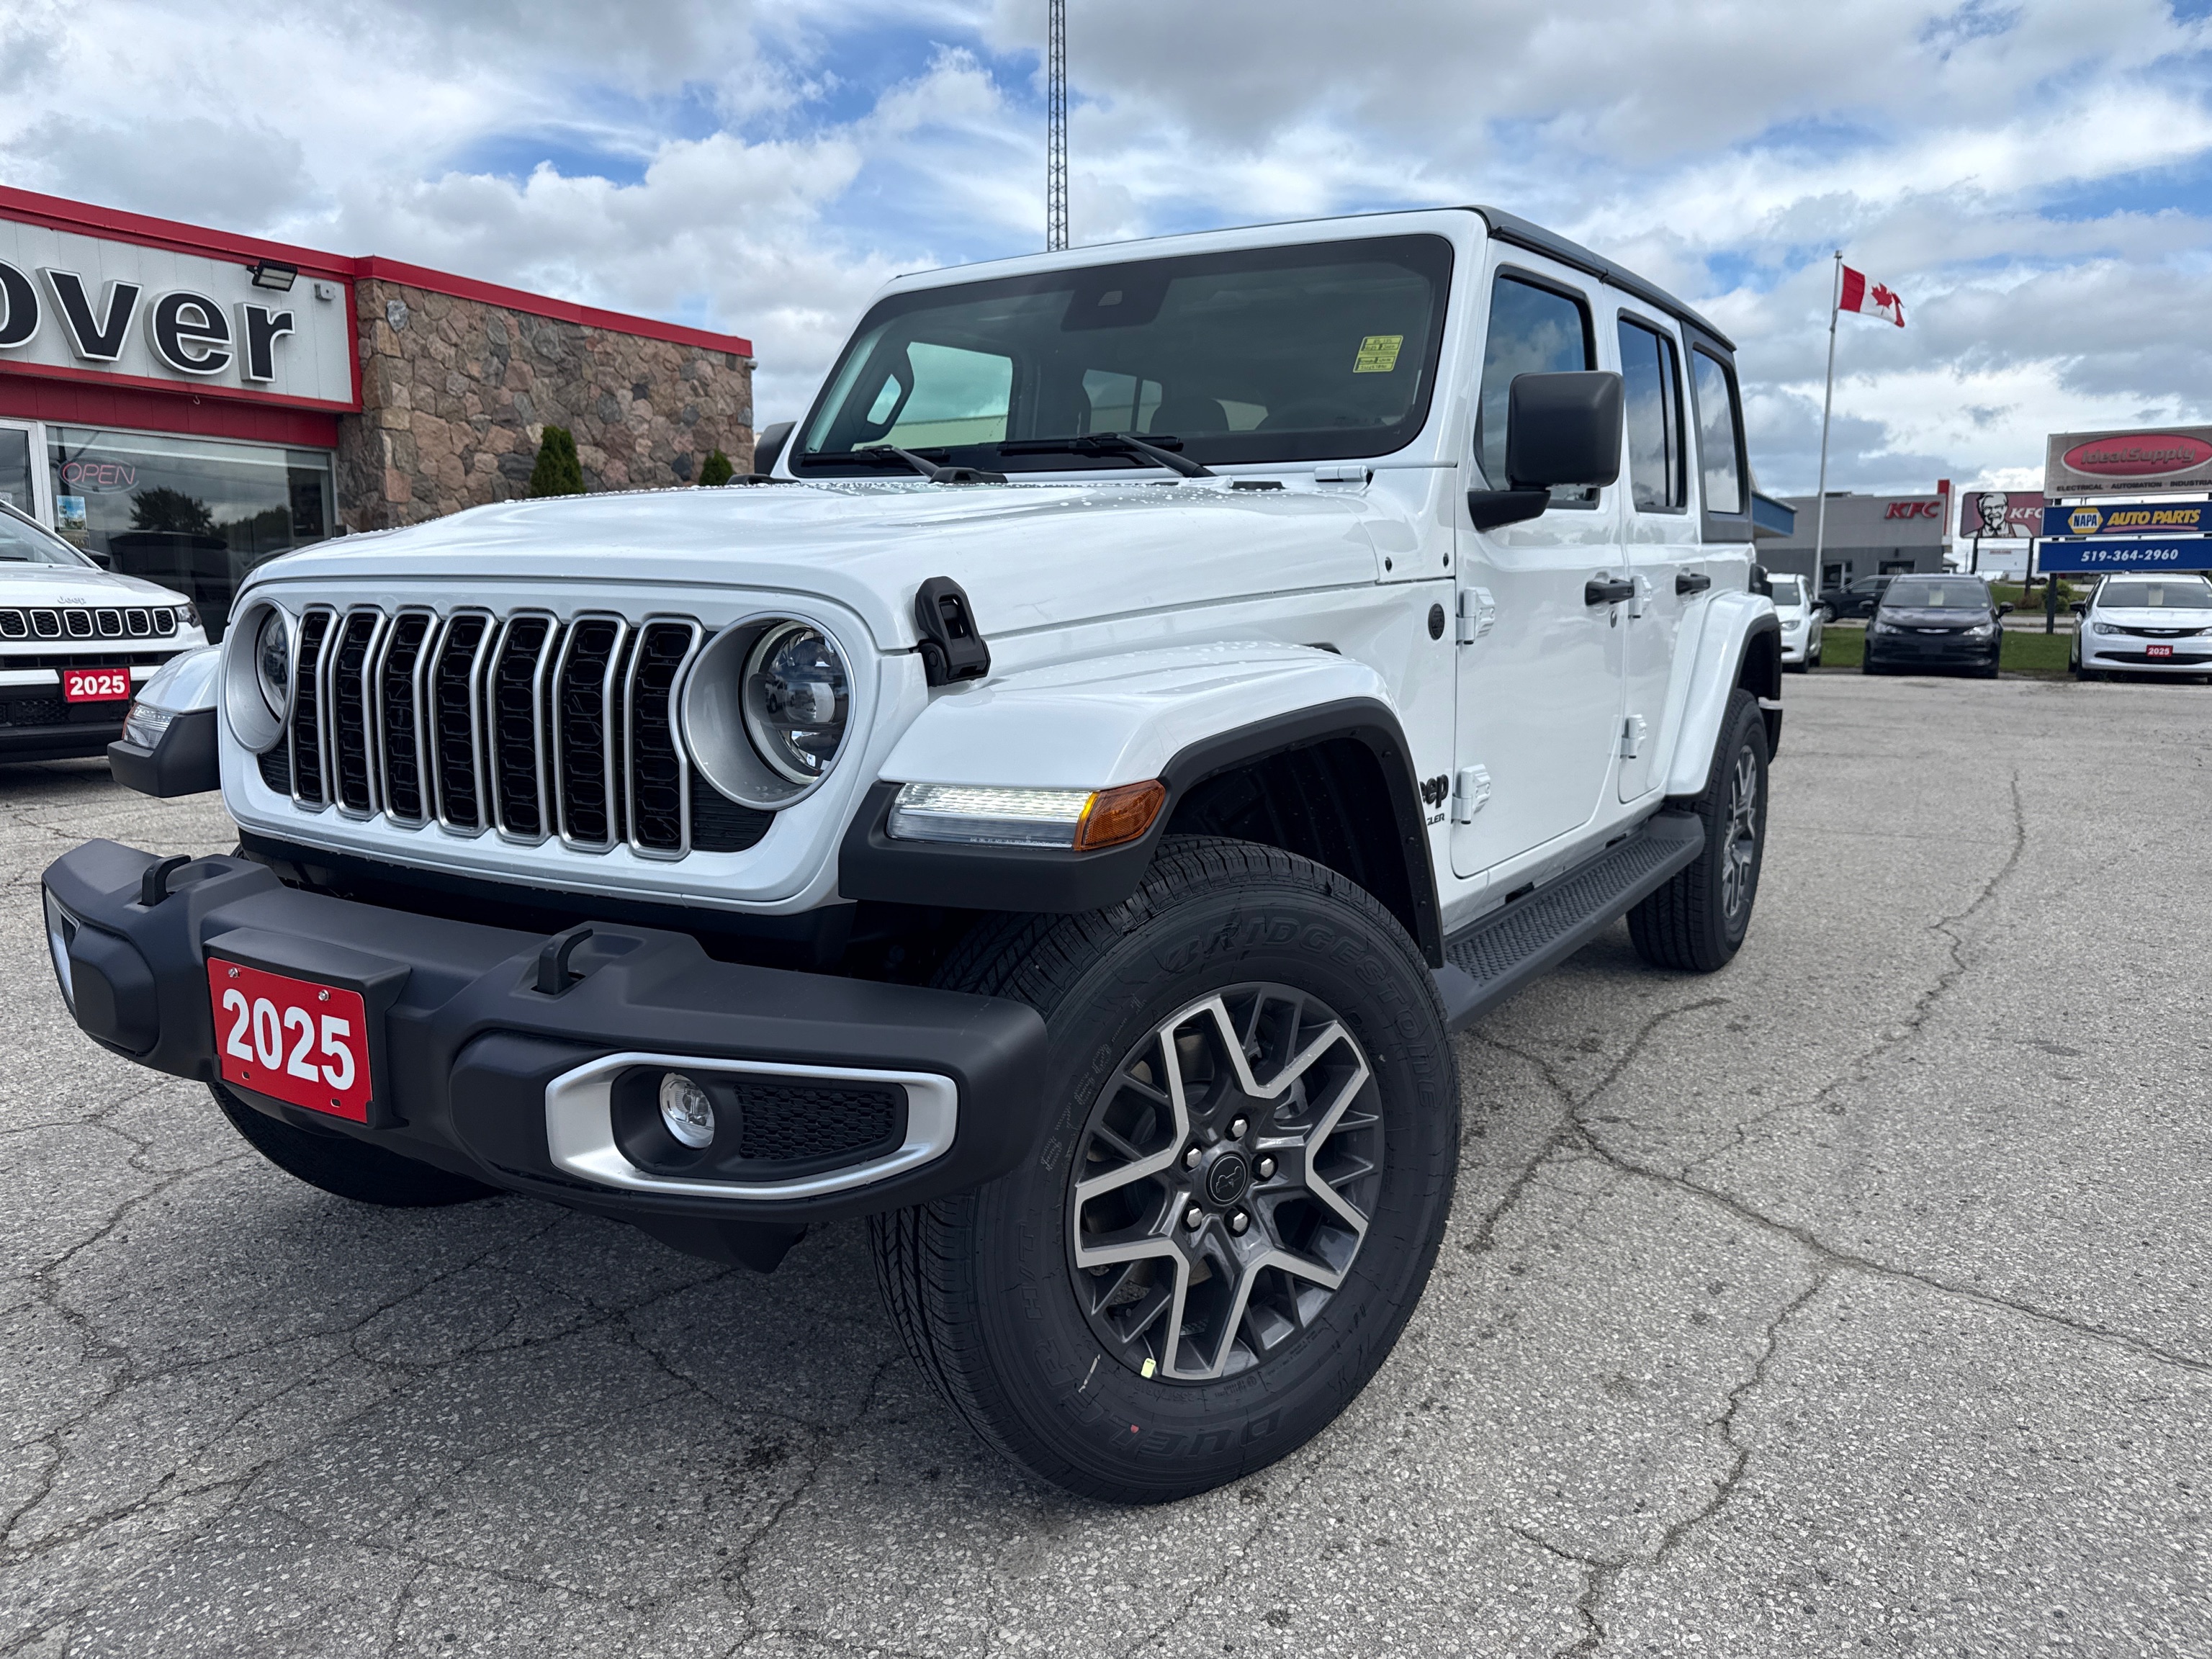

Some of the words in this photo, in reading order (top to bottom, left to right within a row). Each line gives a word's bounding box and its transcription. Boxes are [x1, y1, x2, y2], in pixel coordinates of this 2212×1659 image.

[62, 462, 135, 485] OPEN
[1884, 501, 1941, 519] KFC
[2010, 506, 2042, 519] KFC
[2073, 514, 2098, 526] NAPA
[2107, 511, 2150, 526] AUTO
[2152, 508, 2201, 524] PARTS
[2080, 549, 2179, 562] 519-364-2960
[57, 595, 86, 605] Jeep
[70, 675, 125, 696] 2025
[1164, 916, 1441, 1110] BRIDGESTONE
[223, 989, 356, 1091] 2025
[1033, 1338, 1283, 1460] DUELER
